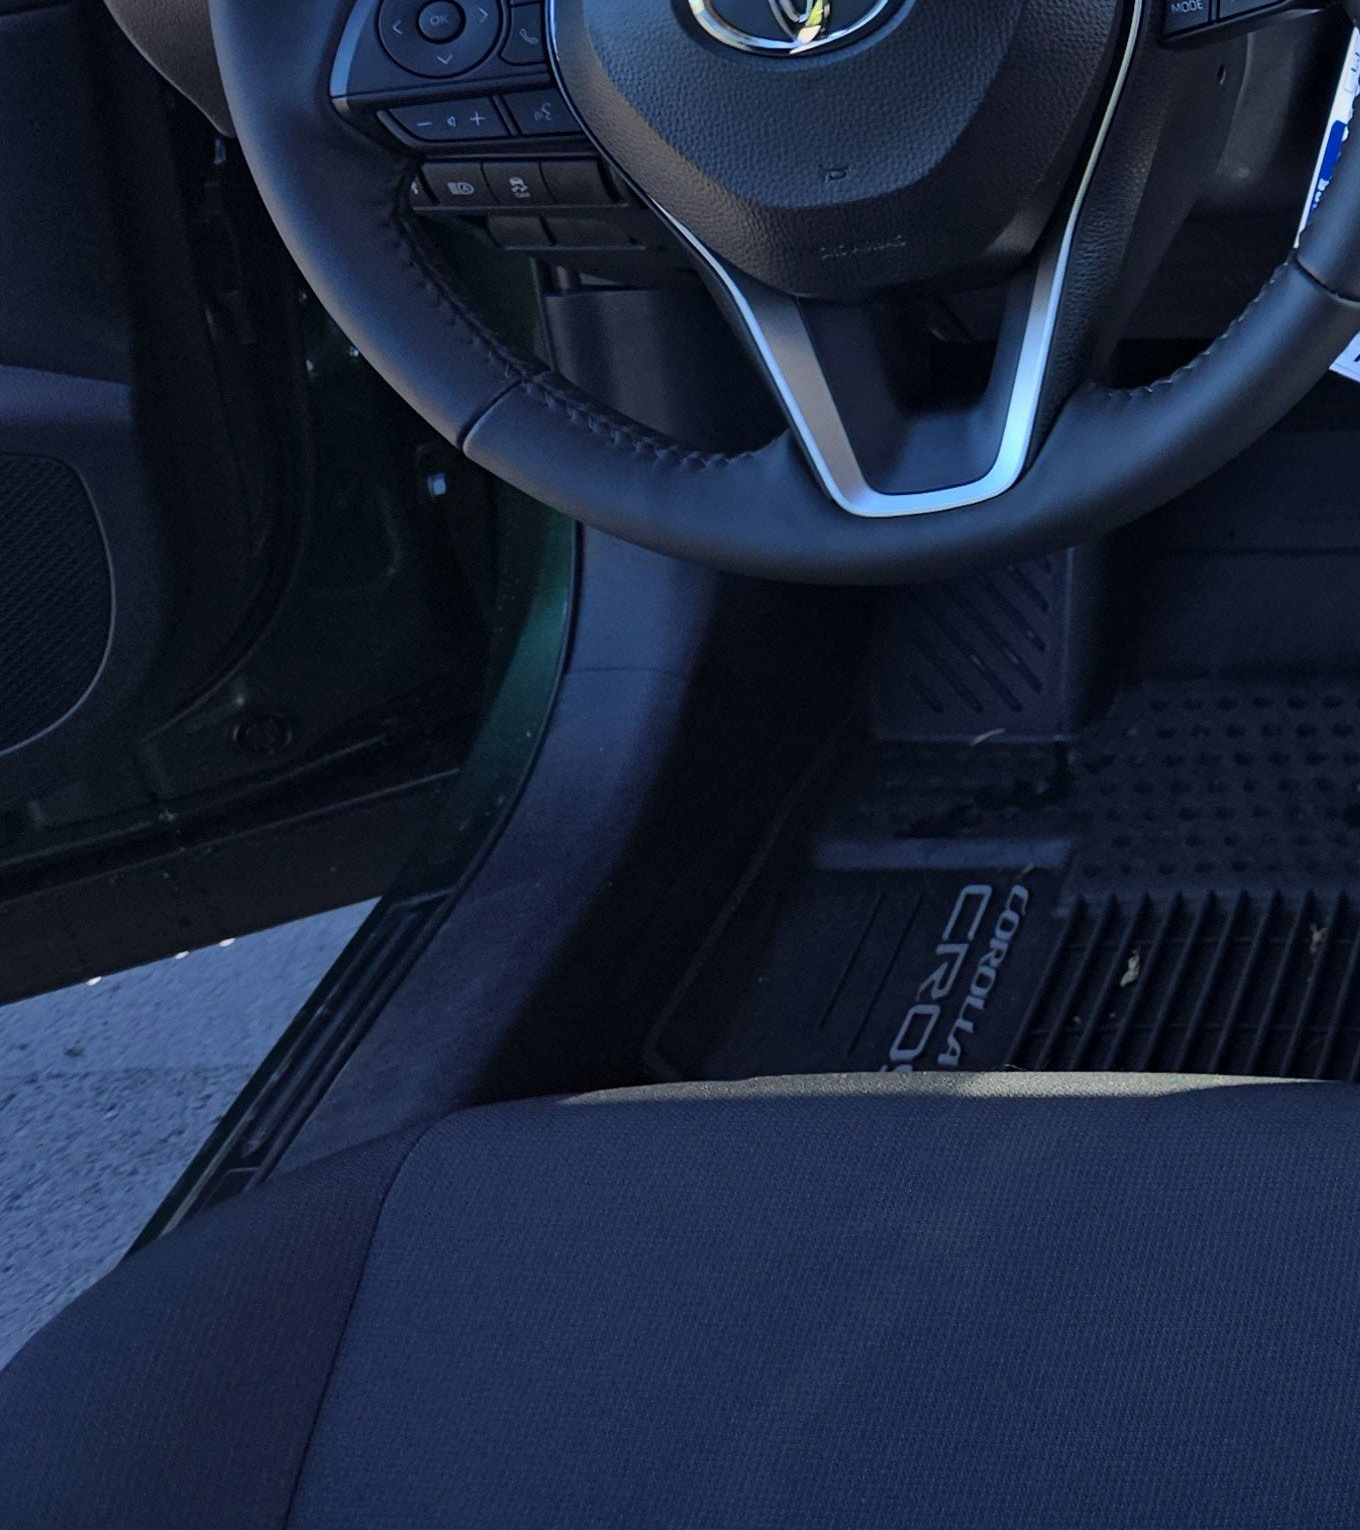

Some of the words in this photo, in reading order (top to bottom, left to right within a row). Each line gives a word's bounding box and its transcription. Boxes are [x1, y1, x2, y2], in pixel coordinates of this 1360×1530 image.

[430, 15, 449, 26] OK
[879, 884, 993, 1072] CRO
[938, 883, 1030, 1066] COROLLA
